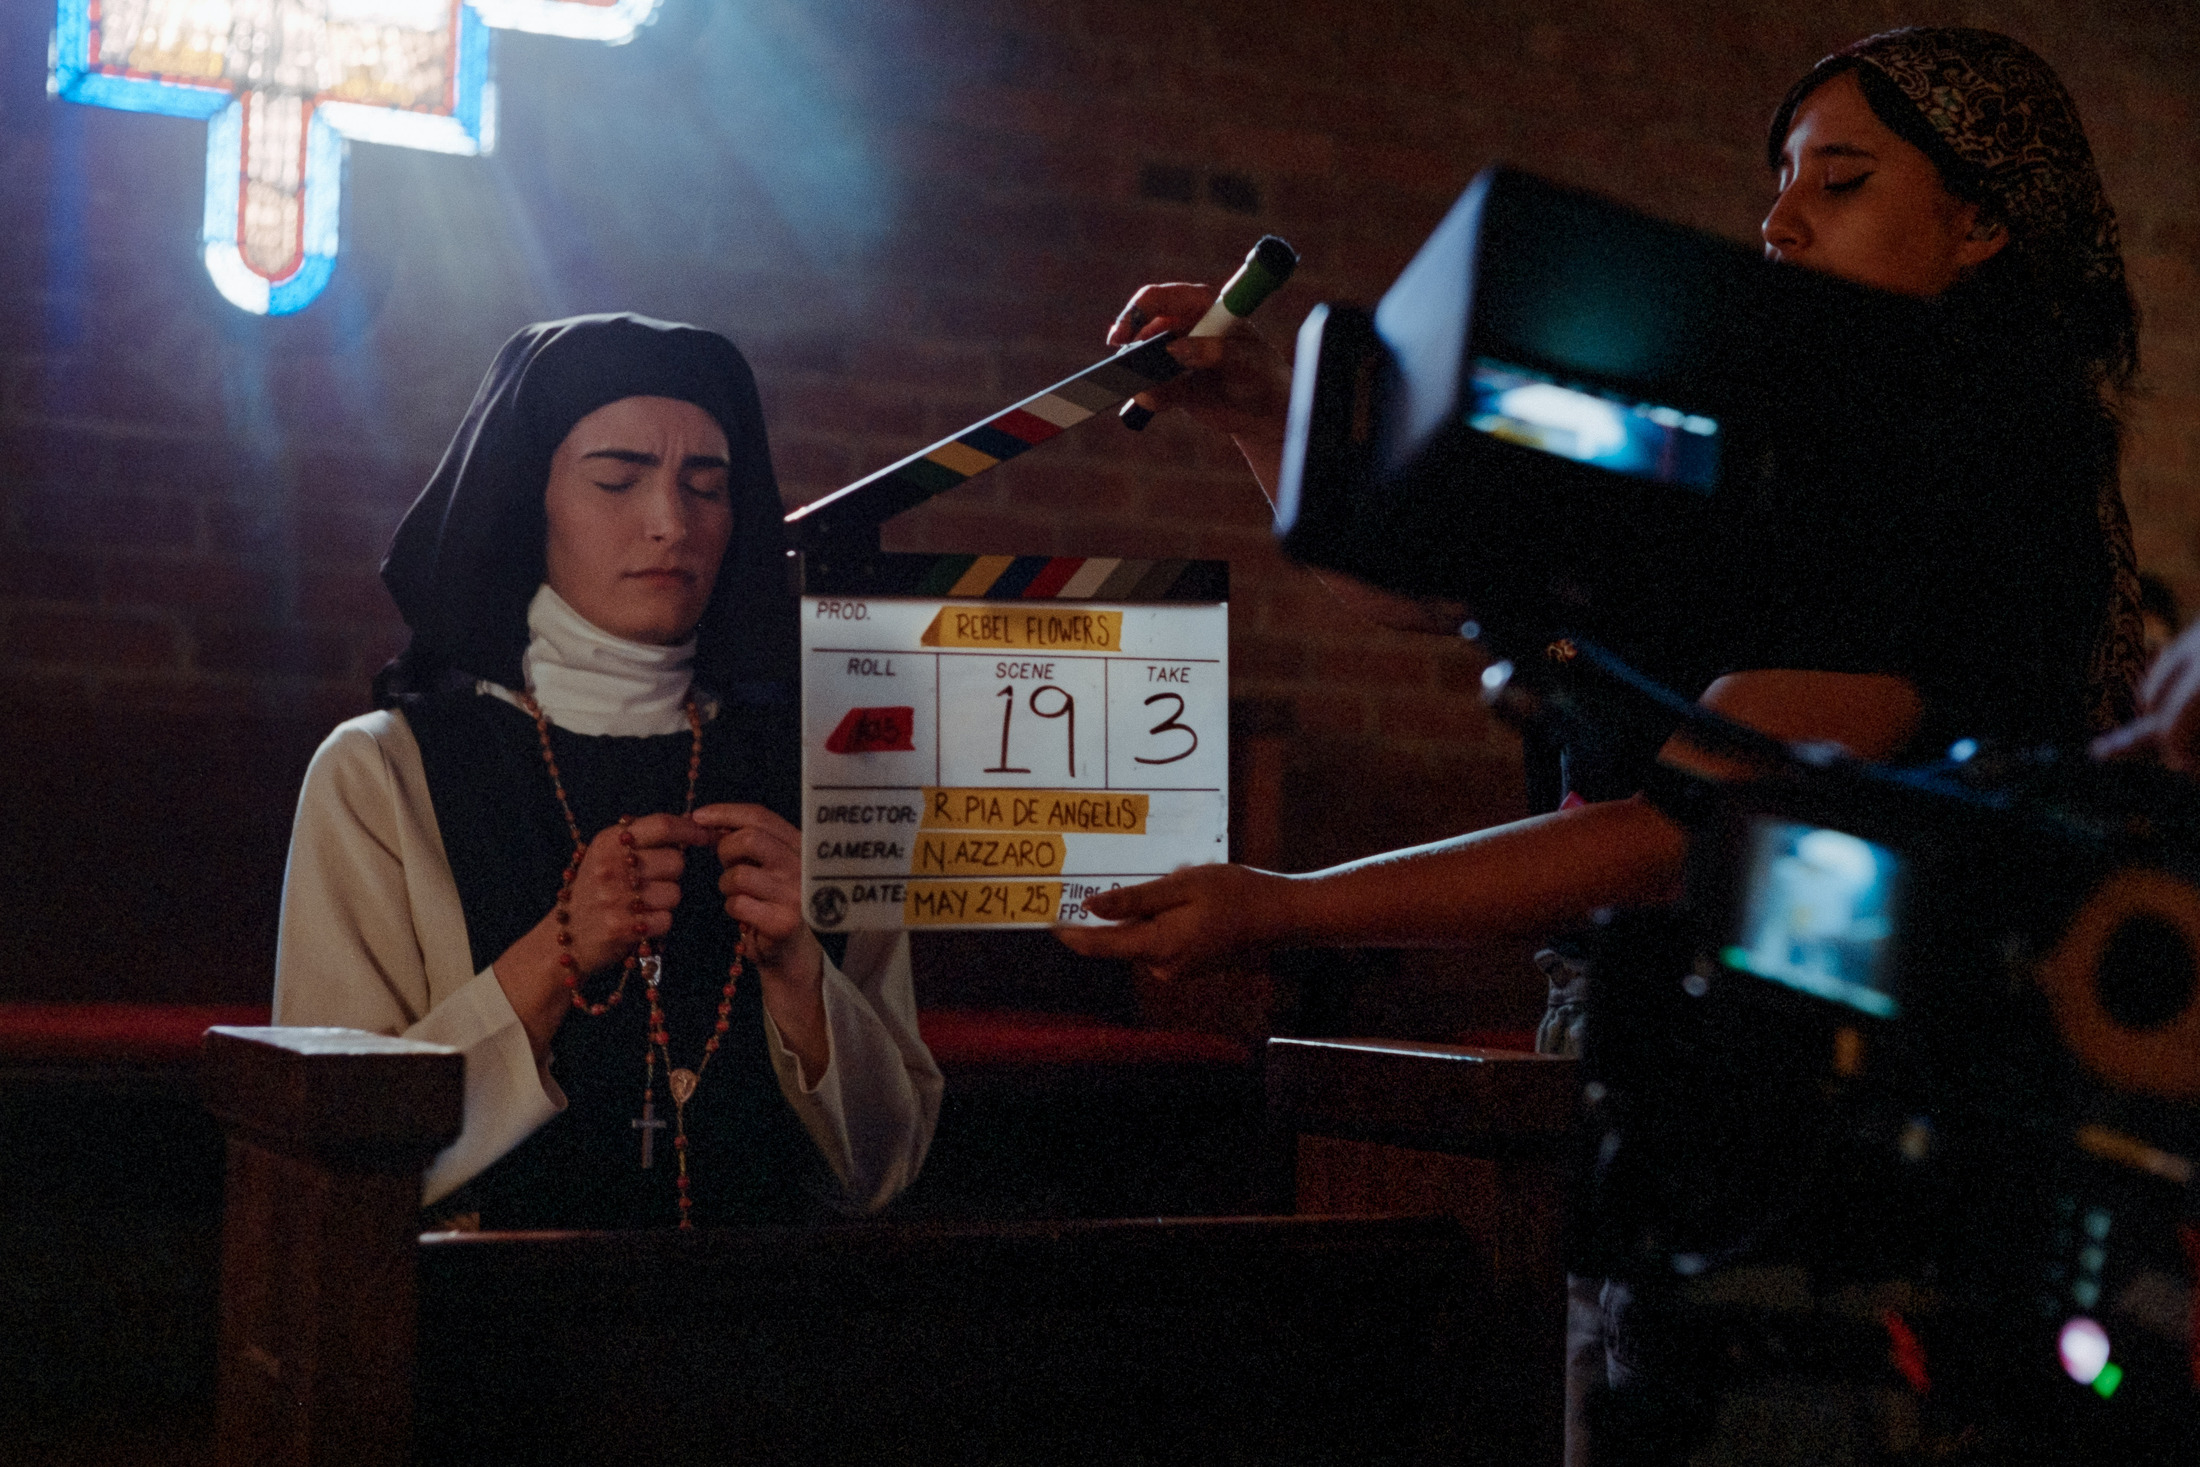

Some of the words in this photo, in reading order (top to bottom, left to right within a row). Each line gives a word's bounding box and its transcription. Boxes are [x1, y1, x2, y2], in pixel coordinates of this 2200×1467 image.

[816, 602, 872, 621] PROD.
[956, 612, 1014, 644] REBEL
[1026, 612, 1111, 647] FLOWERS
[847, 658, 896, 677] ROLL
[996, 662, 1056, 681] SCENE
[1147, 666, 1191, 684] TAKE
[983, 685, 1076, 778] 19
[1134, 692, 1199, 765] 3
[817, 804, 917, 824] DIRECTOR:
[1013, 798, 1040, 827] DE
[1047, 797, 1137, 830] ANGELIS
[817, 840, 904, 860] CAMERA:
[1061, 882, 1101, 900] Filter
[914, 889, 969, 919] MAY
[1021, 885, 1051, 916] 25
